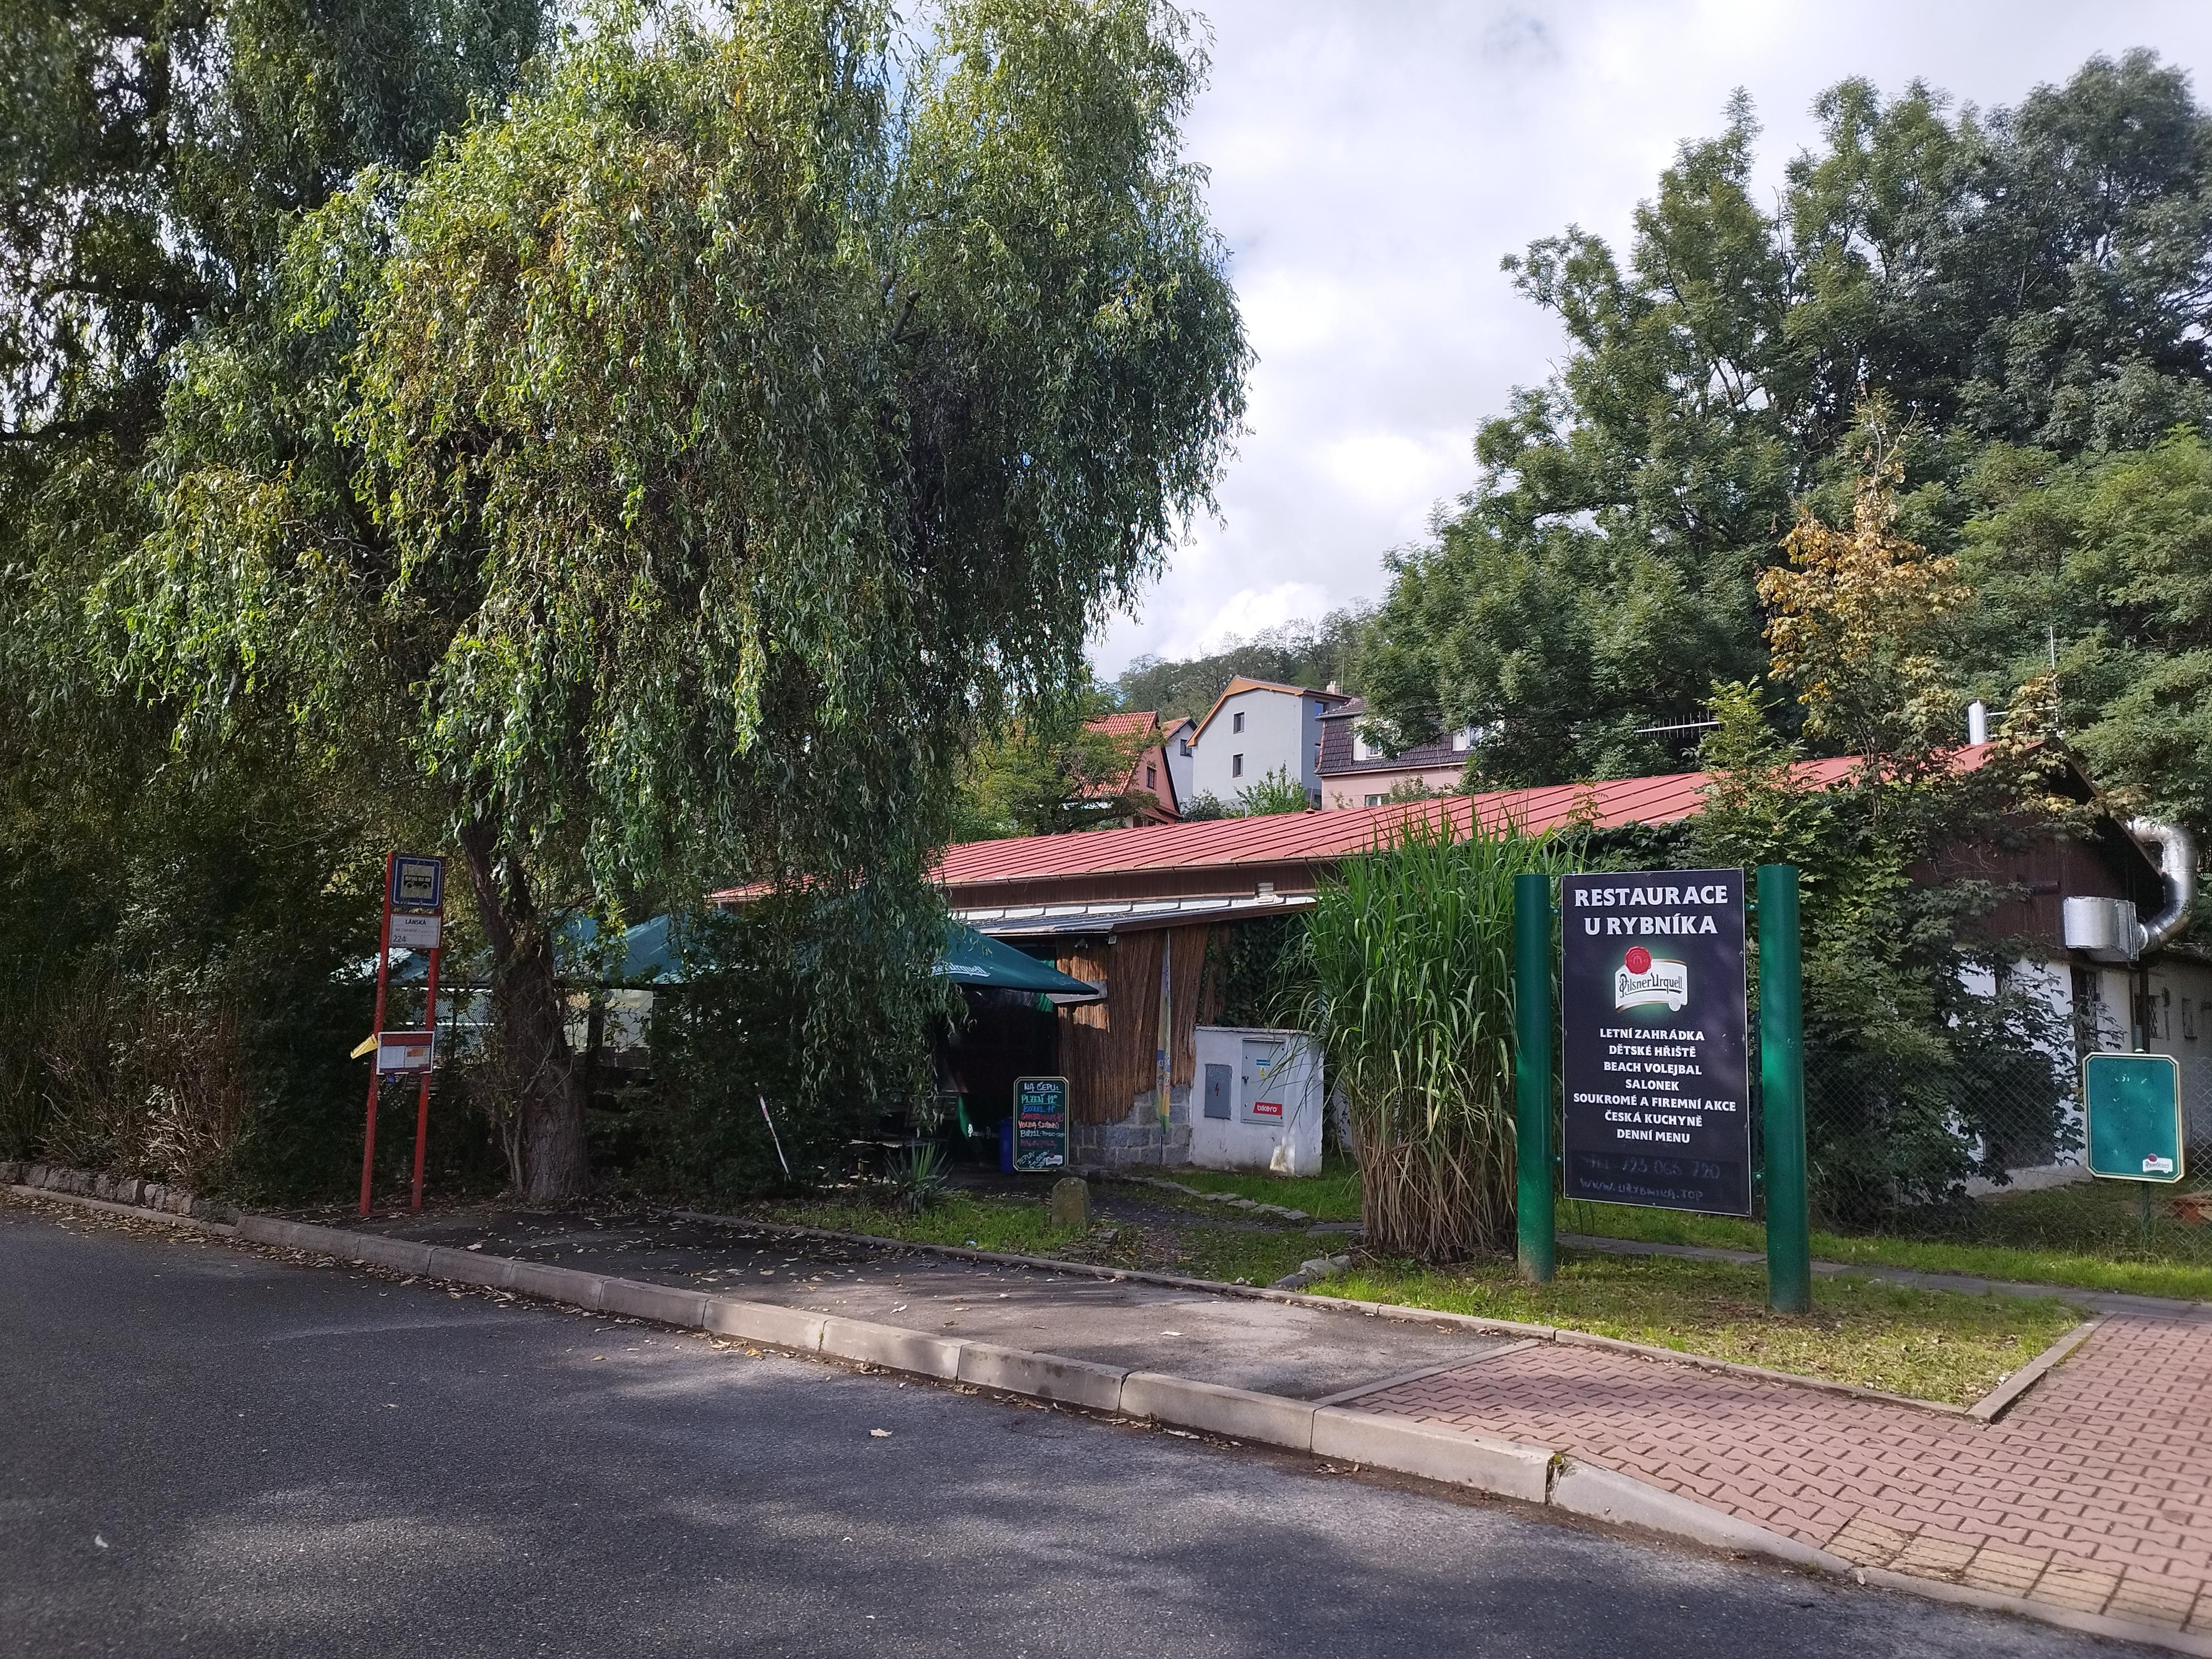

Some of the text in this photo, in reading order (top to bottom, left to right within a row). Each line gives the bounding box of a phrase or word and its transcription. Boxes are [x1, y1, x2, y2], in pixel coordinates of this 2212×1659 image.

[1574, 885, 1728, 907] RESTAURACE
[1584, 912, 1718, 936] U RYBNÍKA
[393, 935, 407, 943] 224
[1619, 972, 1683, 999] Pilsner Urquell
[1599, 1027, 1705, 1041] LETNÍ ZAHRÁDKA
[1609, 1043, 1696, 1058] DĚTSKÉ HŘIŠTĚ
[1604, 1061, 1702, 1076] BEACH VOLEJBAL
[1625, 1079, 1679, 1091] SALONEK
[1257, 1104, 1277, 1113] bikero
[1573, 1093, 1736, 1112] SOUKROMÉ A FIREMNÍ AKCE
[1604, 1109, 1703, 1127] ČESKÁ KUCHYNĚ
[1616, 1129, 1691, 1144] DENNÍ MENU
